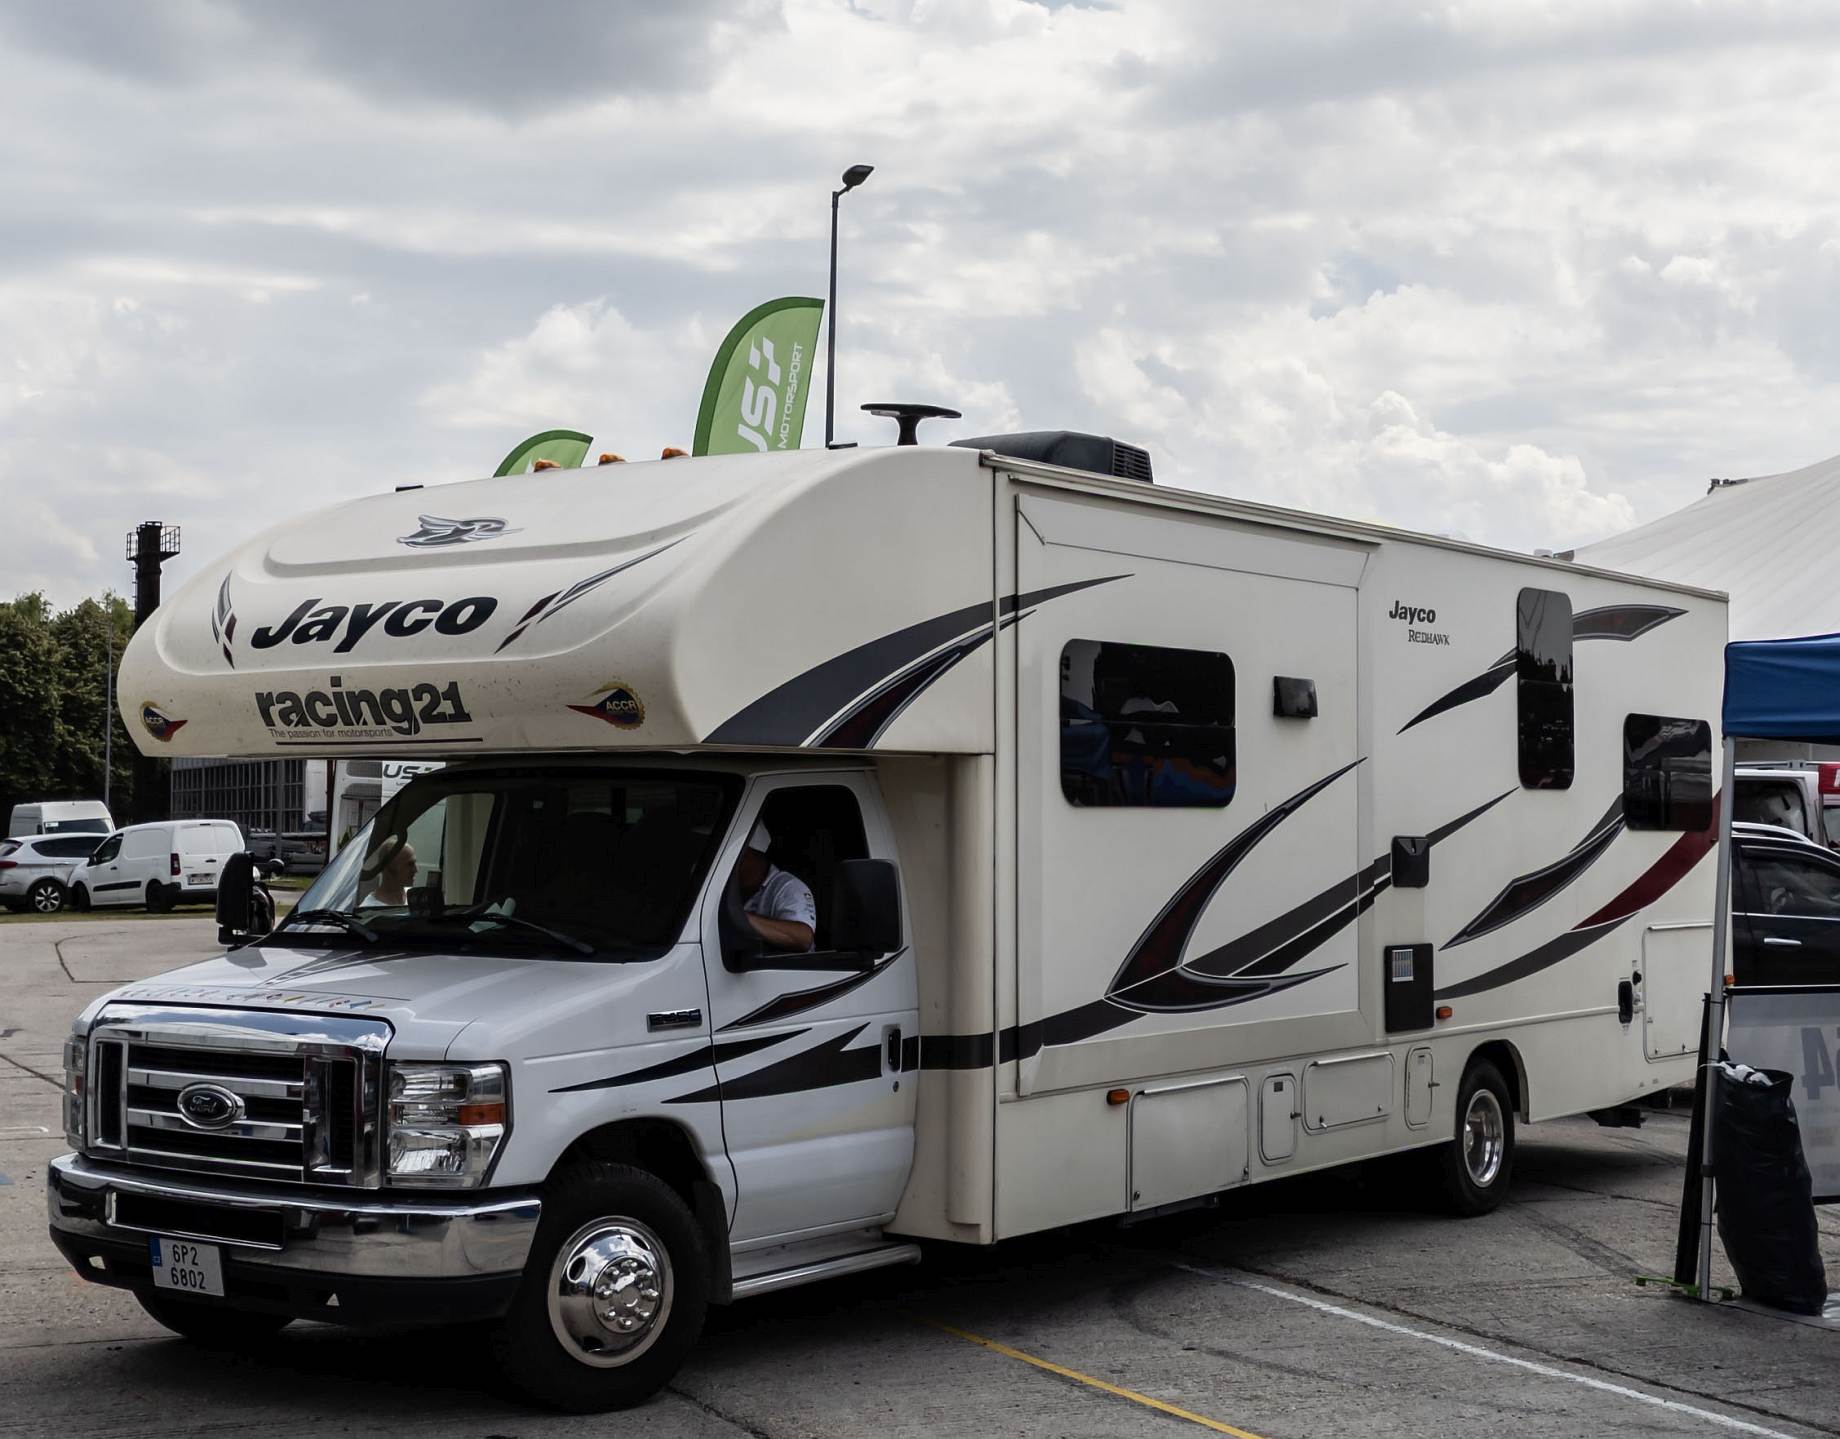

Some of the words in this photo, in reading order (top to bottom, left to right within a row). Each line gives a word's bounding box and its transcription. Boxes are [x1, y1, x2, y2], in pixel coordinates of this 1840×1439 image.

[777, 341, 803, 449] MOTORSPORT
[1388, 600, 1436, 626] Jayco
[250, 597, 498, 654] Jayco
[255, 676, 473, 736] racing21
[605, 700, 637, 712] ACCR
[268, 728, 286, 738] The
[287, 730, 320, 740] passion
[321, 728, 335, 737] for
[337, 727, 393, 738] motorsports
[189, 1095, 218, 1114] Ford
[172, 1244, 199, 1266] 6P2
[171, 1267, 207, 1290] 6802
